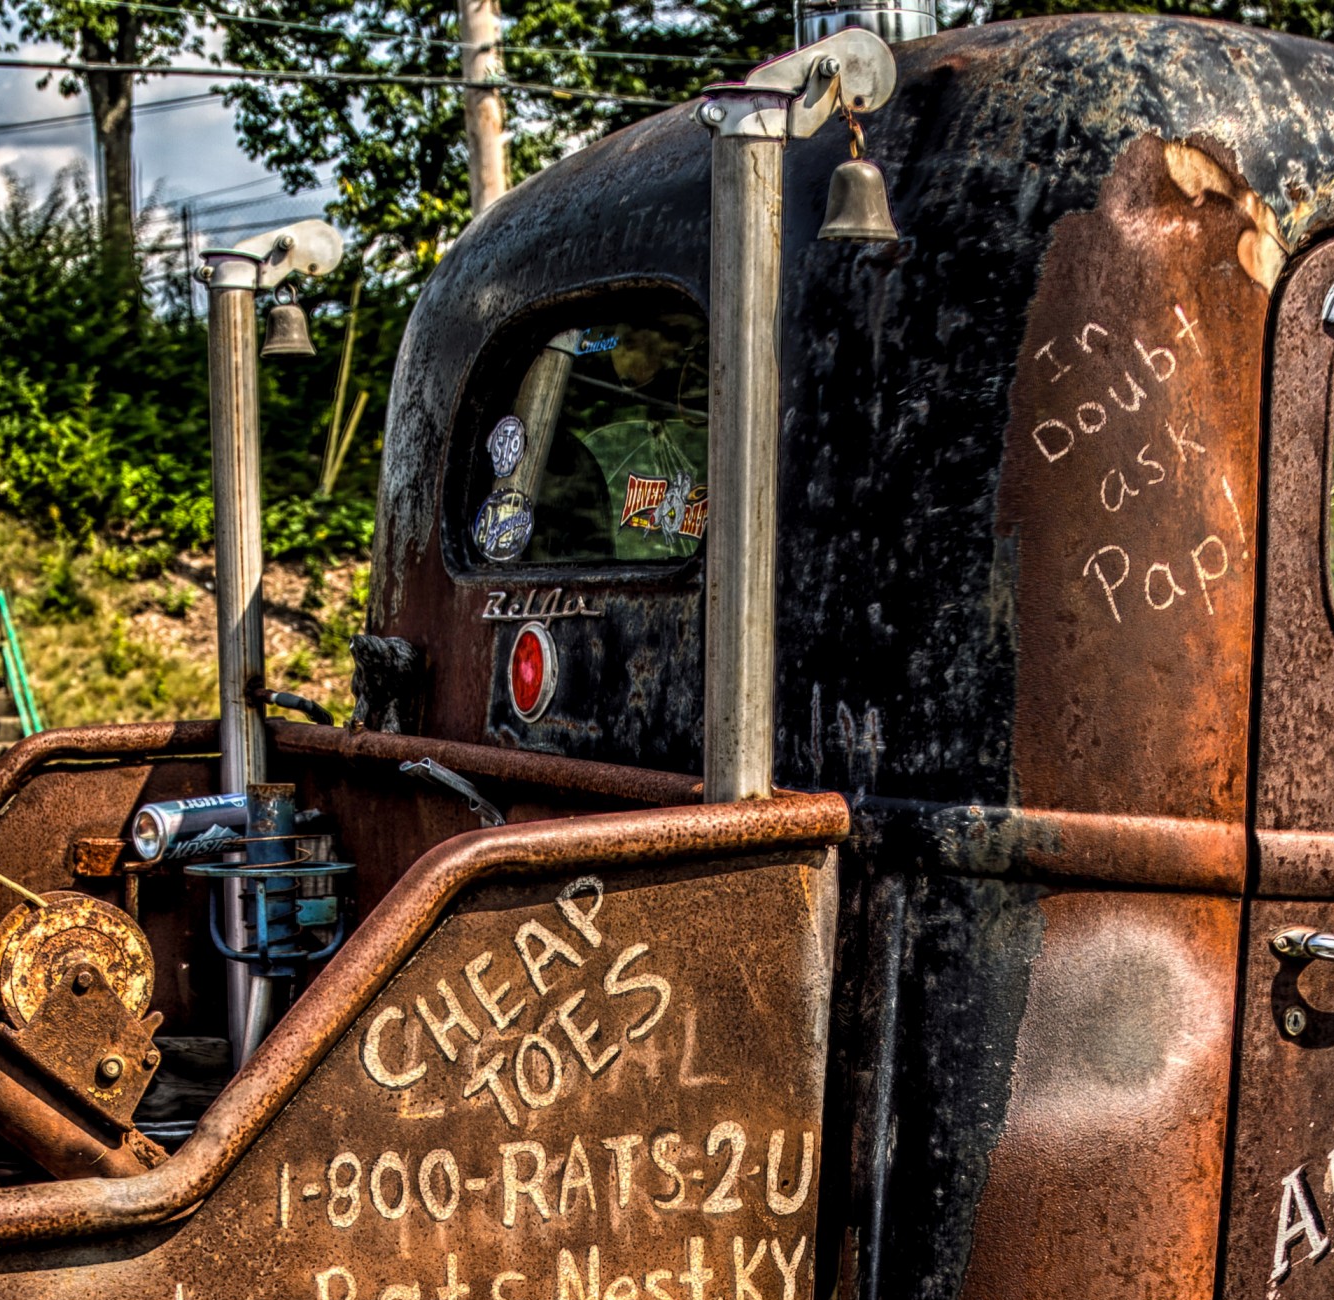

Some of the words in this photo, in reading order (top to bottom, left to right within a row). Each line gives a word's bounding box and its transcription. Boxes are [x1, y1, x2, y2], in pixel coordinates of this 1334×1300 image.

[1032, 303, 1203, 463] Doubt
[1034, 322, 1108, 383] In
[1100, 421, 1207, 512] ask
[362, 874, 605, 1090] CHEAP
[463, 941, 672, 1127] TOES
